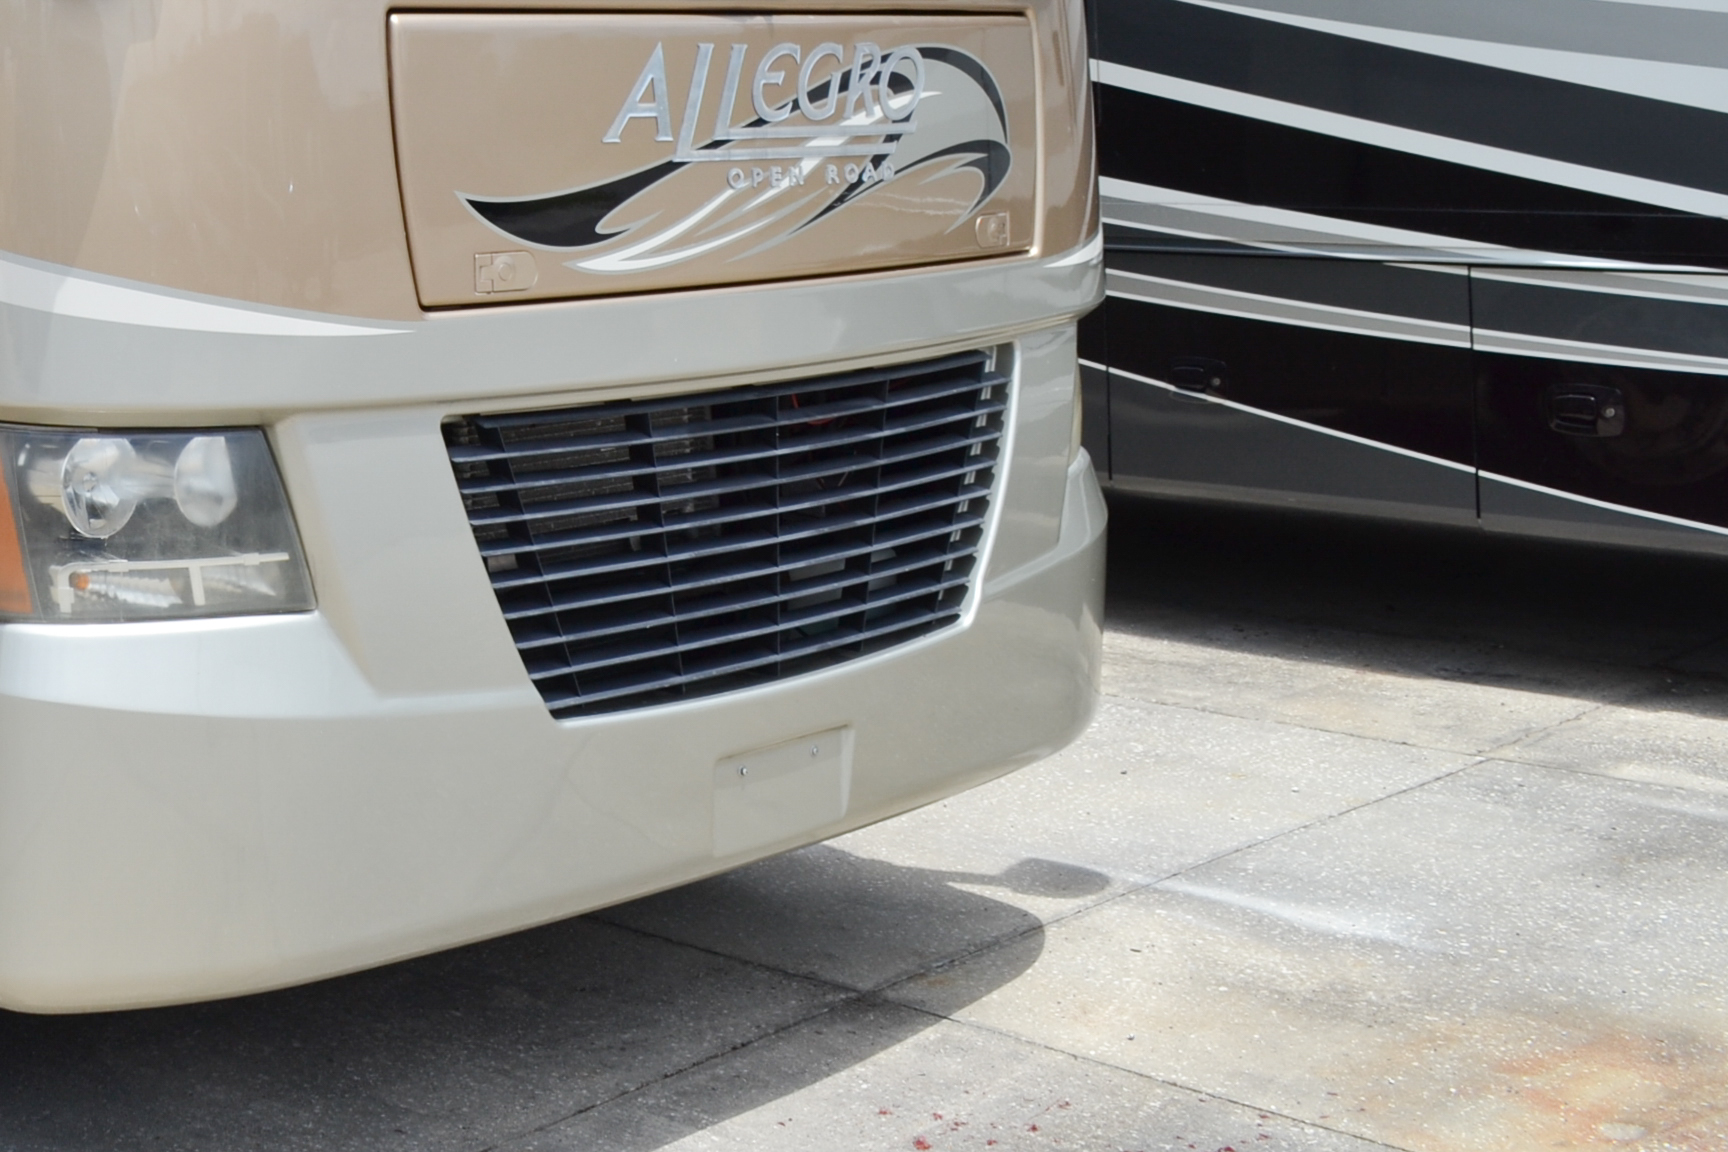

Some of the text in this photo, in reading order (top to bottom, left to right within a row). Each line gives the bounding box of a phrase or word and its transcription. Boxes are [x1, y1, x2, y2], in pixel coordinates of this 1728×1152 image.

[603, 41, 925, 162] ALLEGRO
[727, 159, 895, 189] OPEN ROAD
